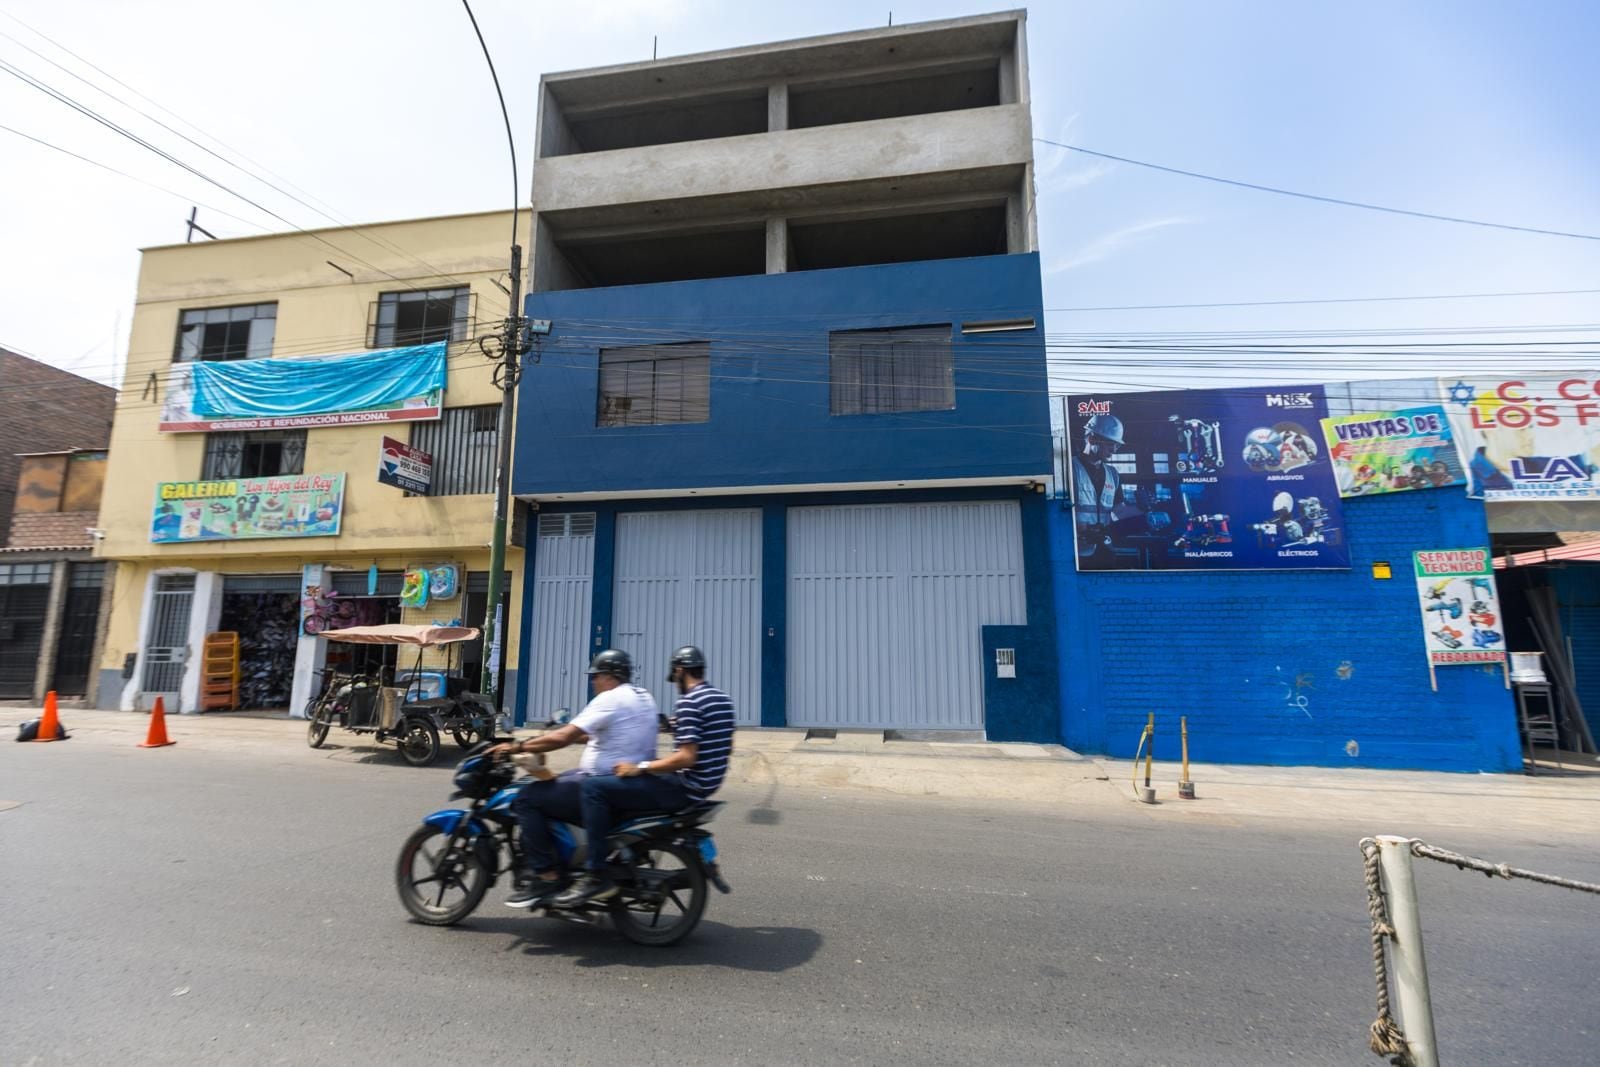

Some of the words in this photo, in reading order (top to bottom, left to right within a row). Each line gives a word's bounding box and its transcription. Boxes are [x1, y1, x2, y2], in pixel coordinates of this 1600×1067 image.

[210, 420, 258, 430] GOBIERNO
[260, 419, 272, 428] DE
[274, 414, 339, 427] REFUNDACIÓN
[341, 412, 390, 423] NACIONAL
[1334, 416, 1412, 441] VENTAS
[1414, 414, 1441, 433] DE
[1470, 405, 1561, 429] LOS
[1509, 457, 1589, 481] LA
[161, 482, 237, 501] GALERIA
[293, 477, 310, 490] del
[1184, 550, 1233, 558] INALÁMBRICOS
[1418, 551, 1485, 563] SERVICIO
[1423, 562, 1484, 573] TECNICO
